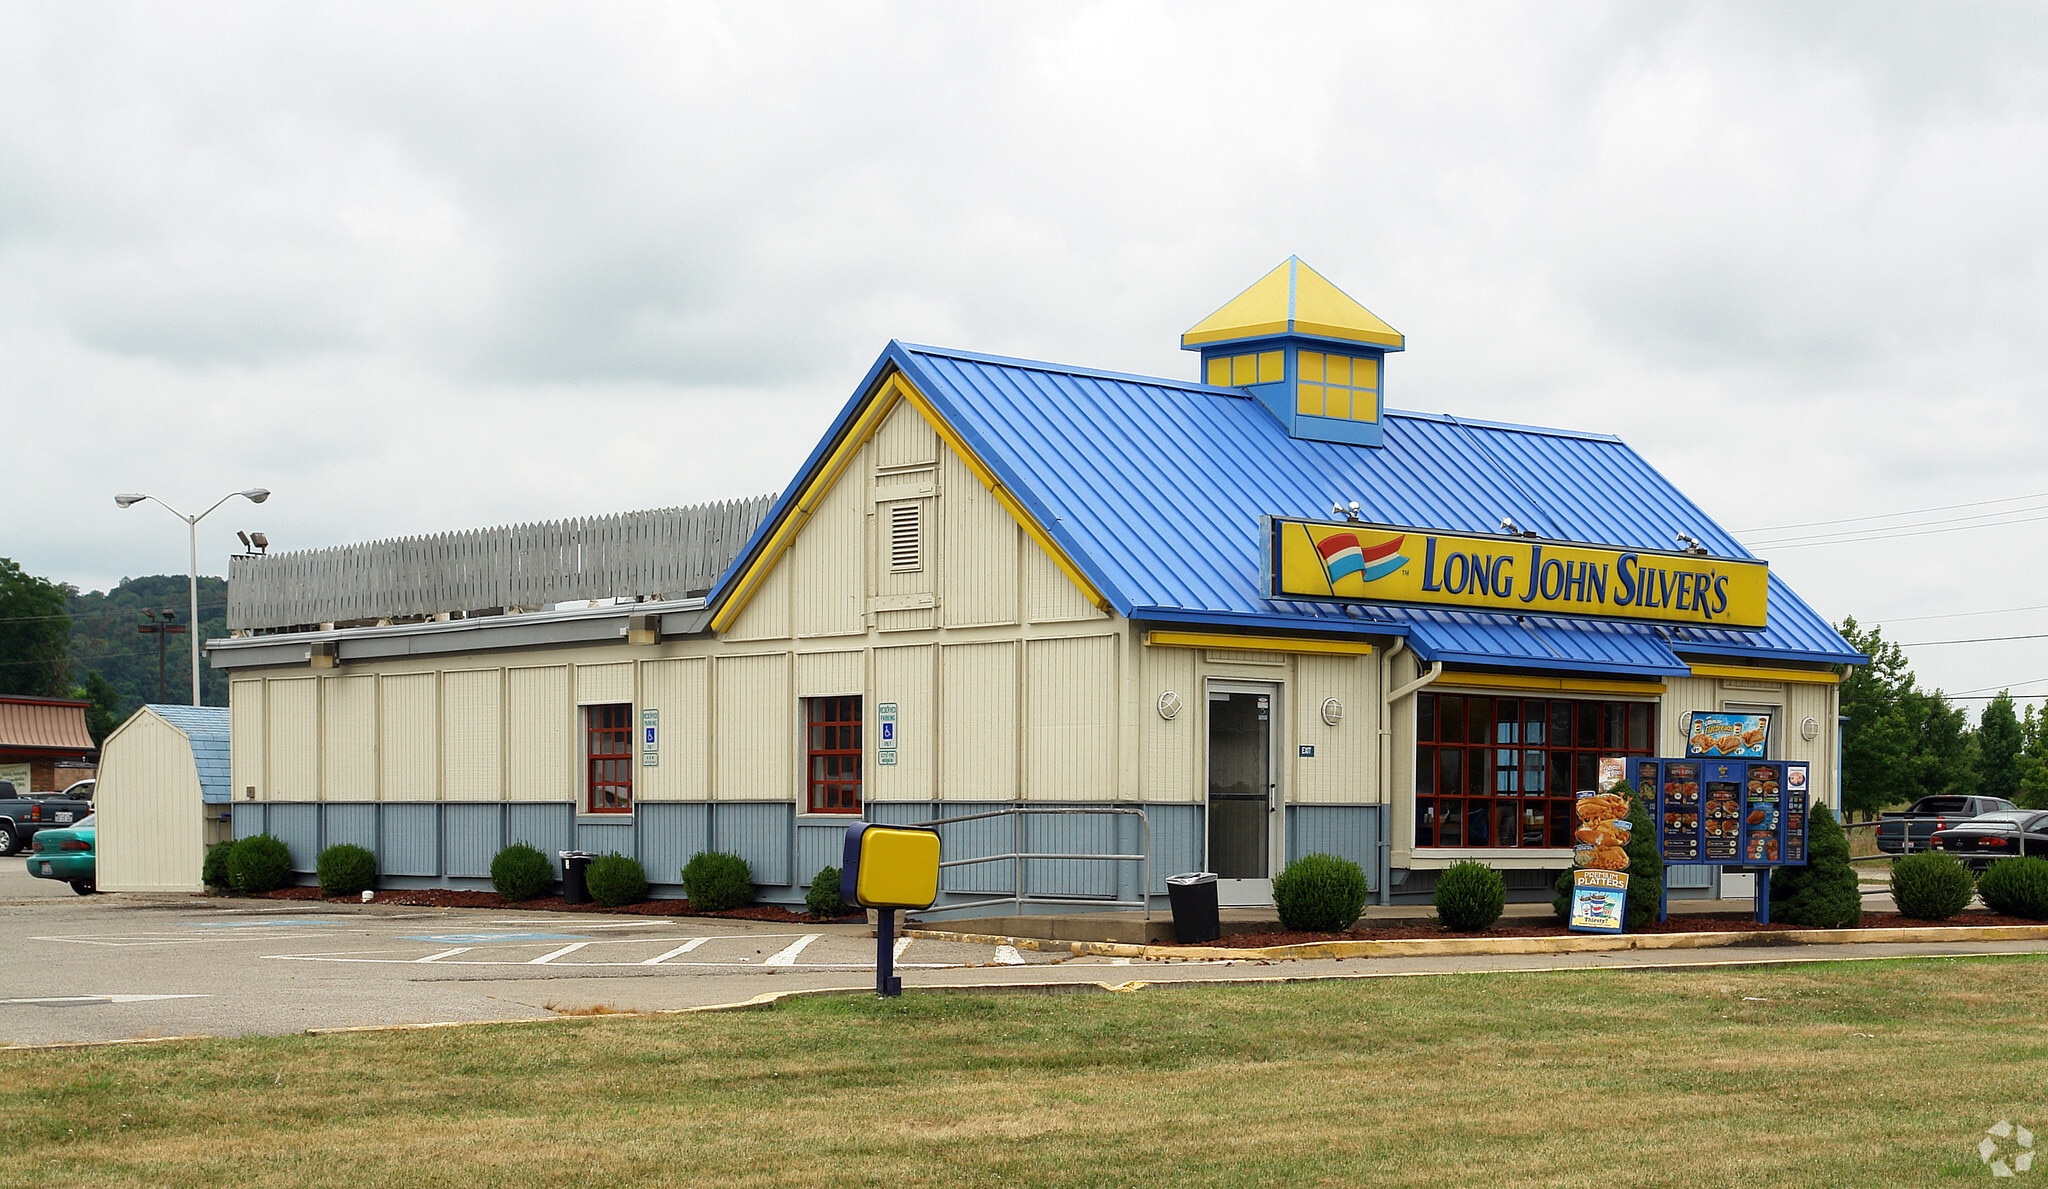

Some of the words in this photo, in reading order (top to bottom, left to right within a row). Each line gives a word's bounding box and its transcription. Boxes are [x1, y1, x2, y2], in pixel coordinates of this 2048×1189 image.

[1422, 536, 1513, 597] LONG
[1518, 546, 1609, 604] JOHN
[1613, 552, 1729, 620] SILVER'S
[1301, 746, 1312, 755] EXIT
[1584, 871, 1619, 880] PREMIUM
[1578, 877, 1625, 888] PLATTERS
